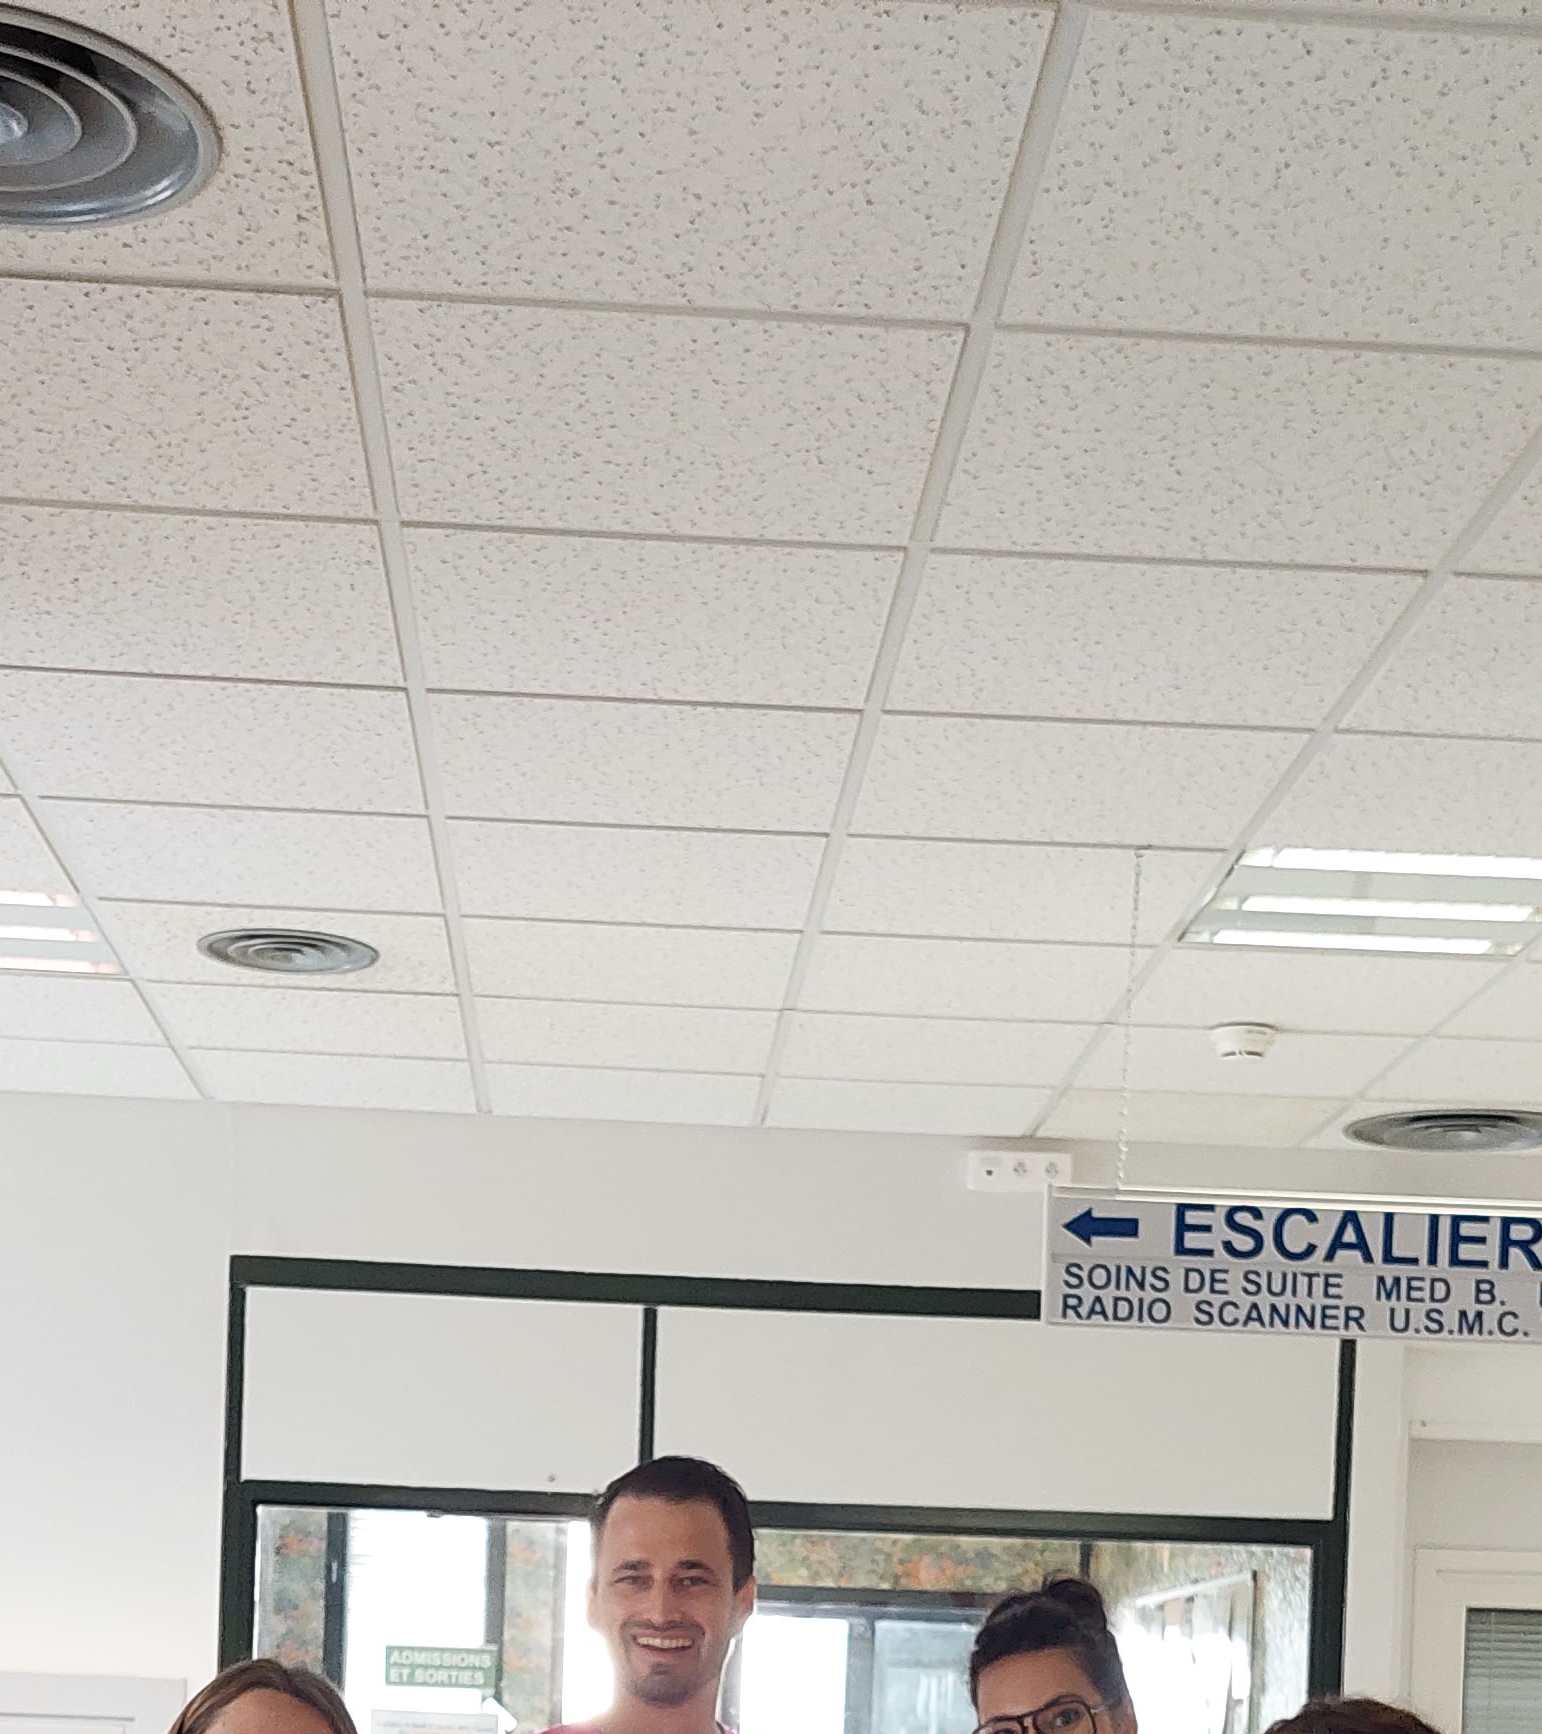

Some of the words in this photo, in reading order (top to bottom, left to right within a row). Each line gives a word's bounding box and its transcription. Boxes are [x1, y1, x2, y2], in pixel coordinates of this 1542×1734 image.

[1062, 1262, 1170, 1293] SOINS
[1183, 1267, 1229, 1295] DE
[1241, 1269, 1344, 1300] SUITE
[1375, 1275, 1452, 1303] MED
[1473, 1278, 1507, 1307] B.
[1060, 1293, 1172, 1325] RADIO
[1193, 1299, 1367, 1332] SCANNER
[1388, 1307, 1530, 1338] U.S.M.C.
[389, 1649, 492, 1669] ADMISSIONS
[389, 1666, 411, 1683] ET
[413, 1667, 485, 1686] SORTIES
